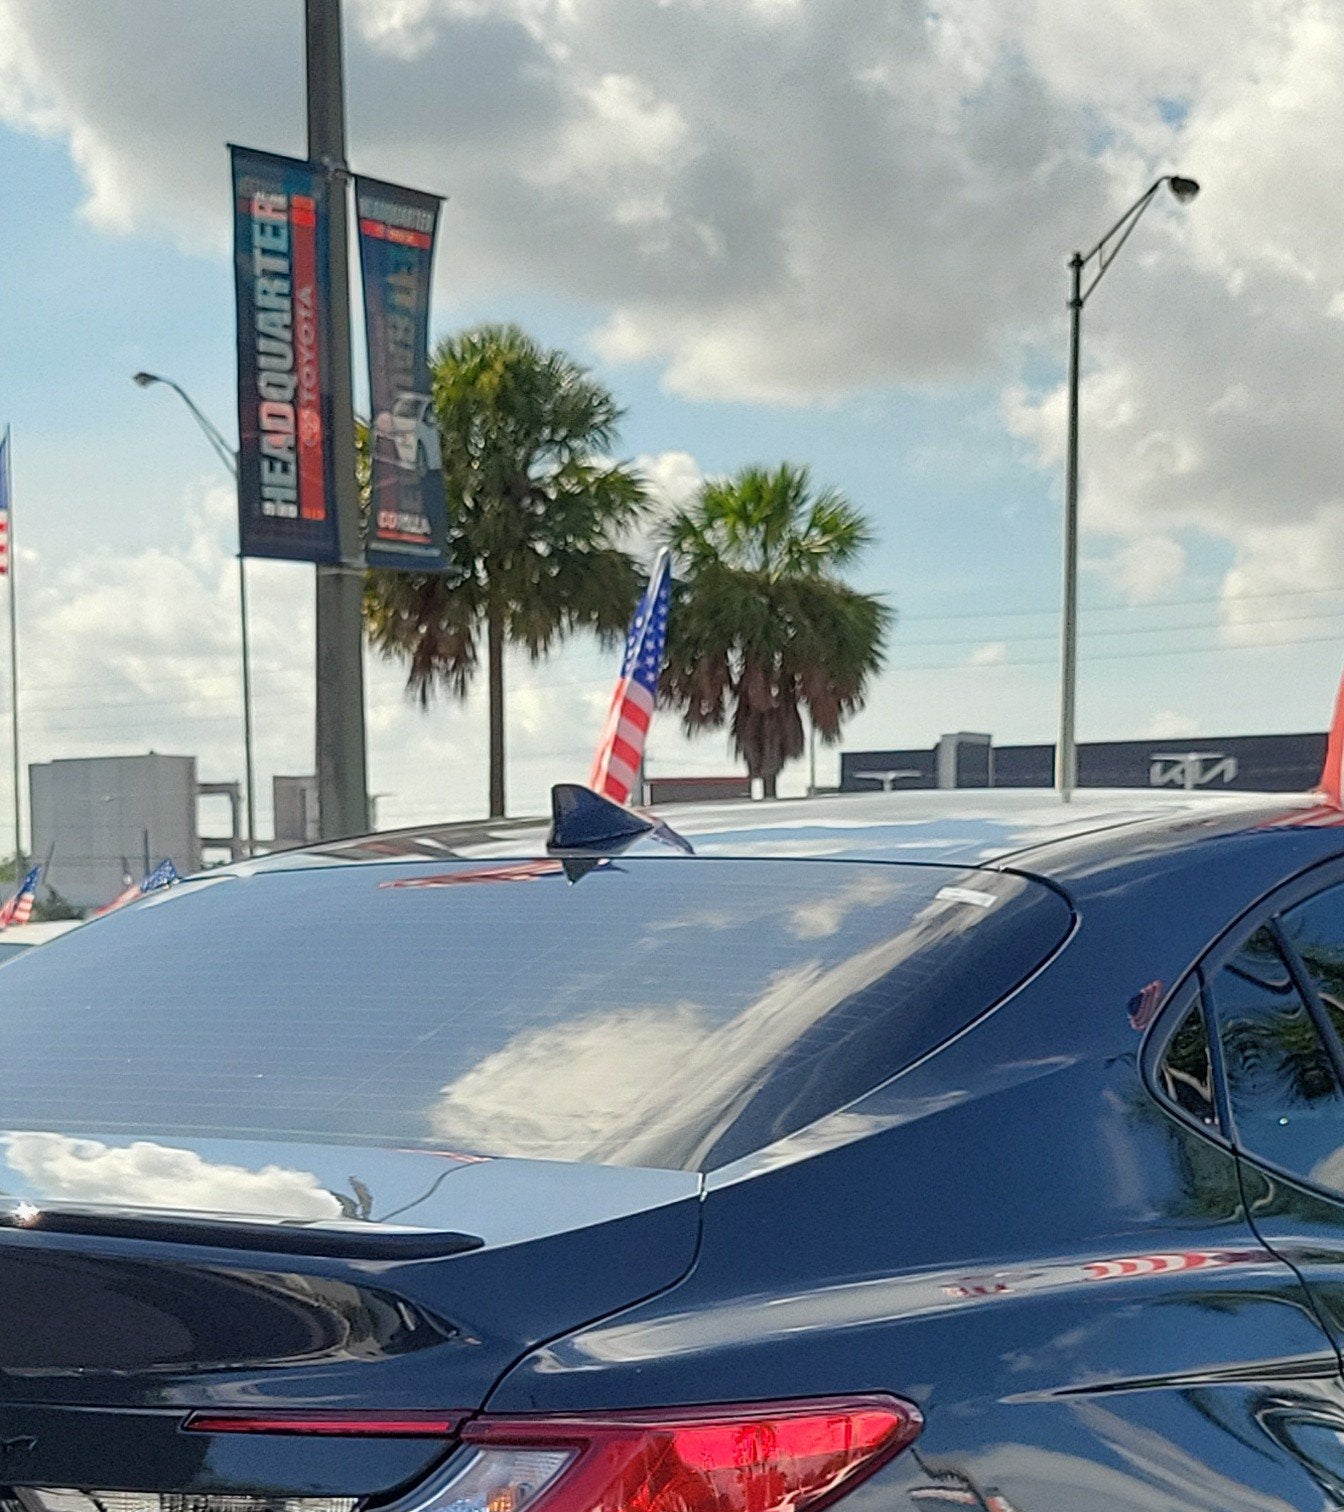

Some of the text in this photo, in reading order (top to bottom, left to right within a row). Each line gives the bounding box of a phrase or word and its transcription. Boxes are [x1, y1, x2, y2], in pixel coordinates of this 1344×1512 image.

[251, 191, 298, 518] HEADQUARTER
[296, 285, 320, 405] TOYOTA
[1149, 755, 1239, 786] KIA
